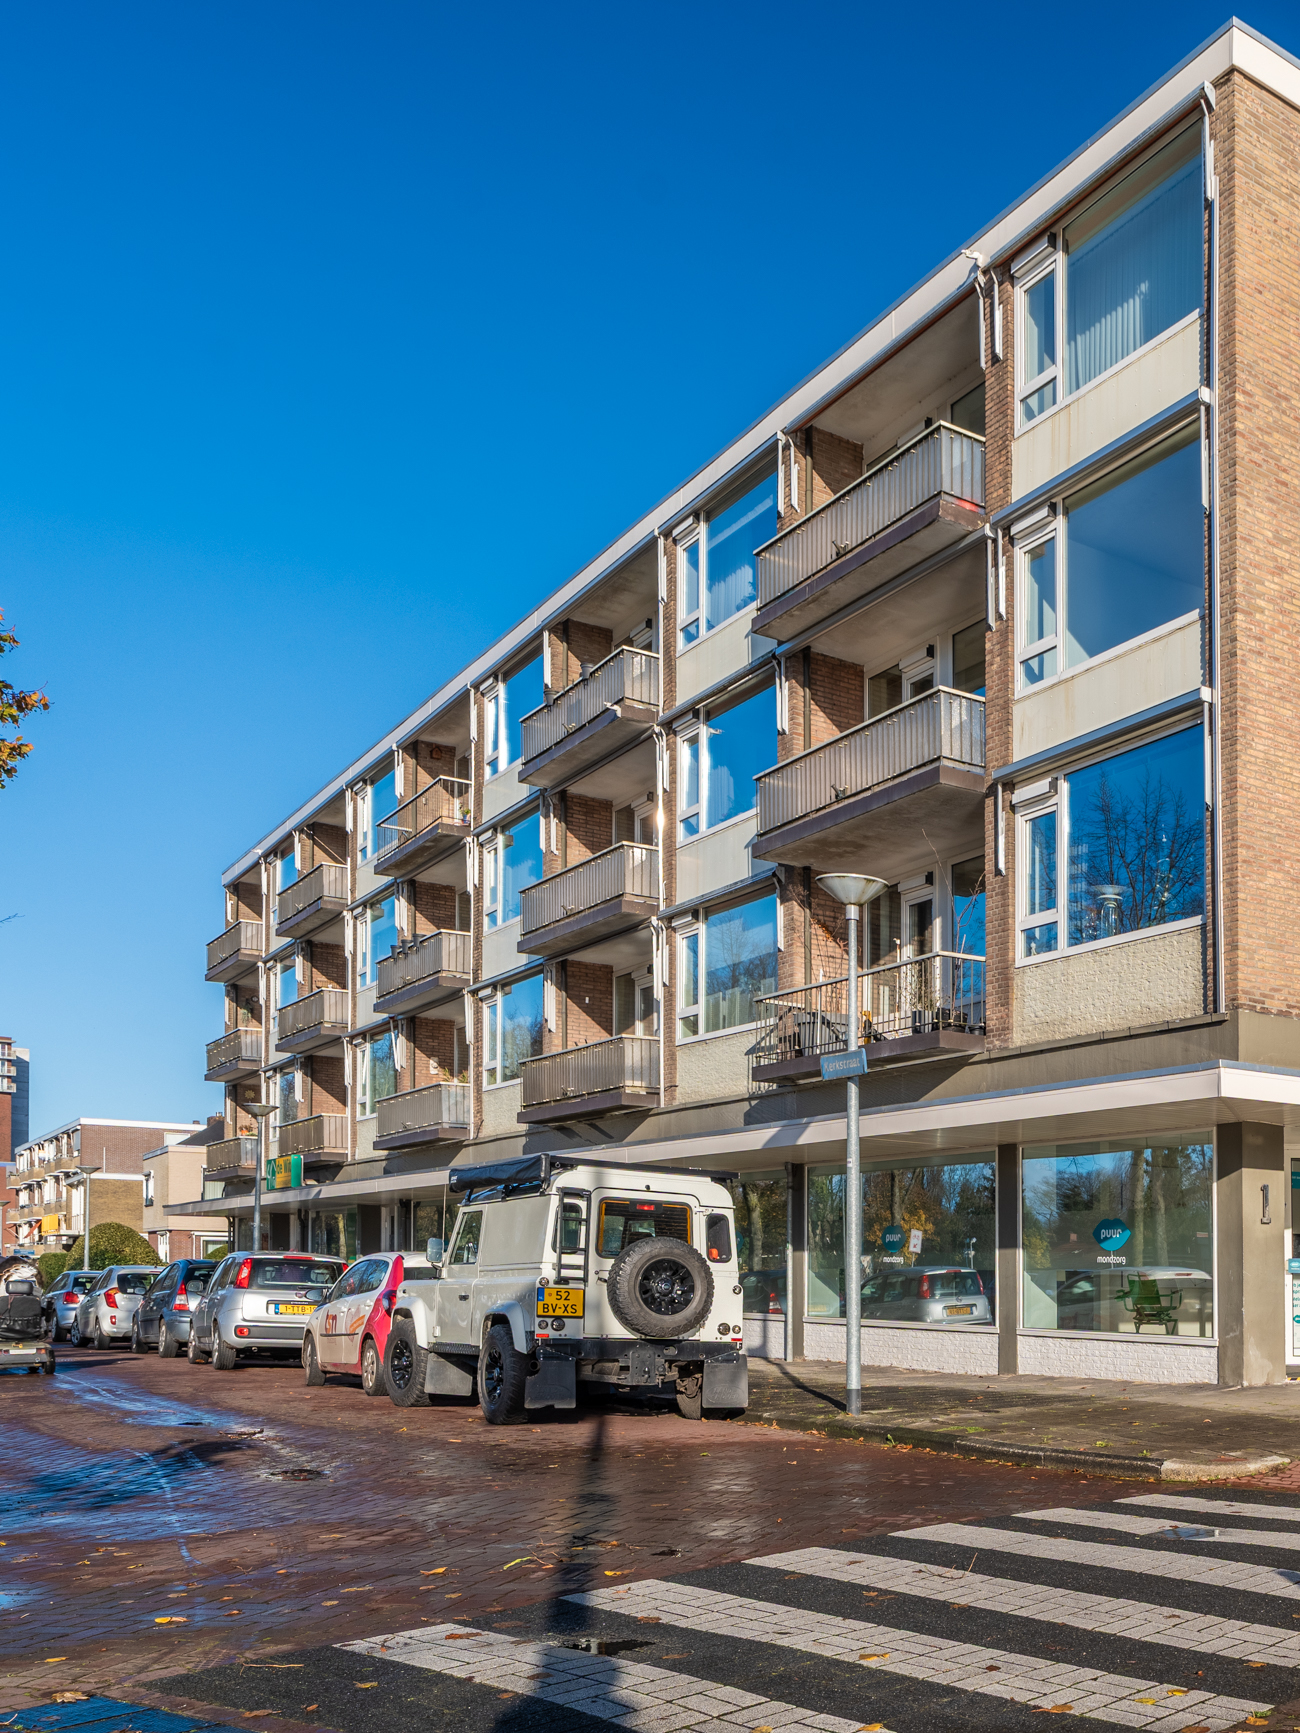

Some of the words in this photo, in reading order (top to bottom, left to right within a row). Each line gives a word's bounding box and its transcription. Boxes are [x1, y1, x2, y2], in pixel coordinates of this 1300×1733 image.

[823, 1058, 860, 1072] Kerkstraat
[1260, 1184, 1271, 1225] 1
[885, 1233, 902, 1243] puur
[1100, 1228, 1123, 1240] puur
[882, 1256, 904, 1265] mondzorg
[1096, 1254, 1126, 1265] mondzorg
[555, 1290, 571, 1302] 52
[542, 1303, 578, 1315] BV-XS
